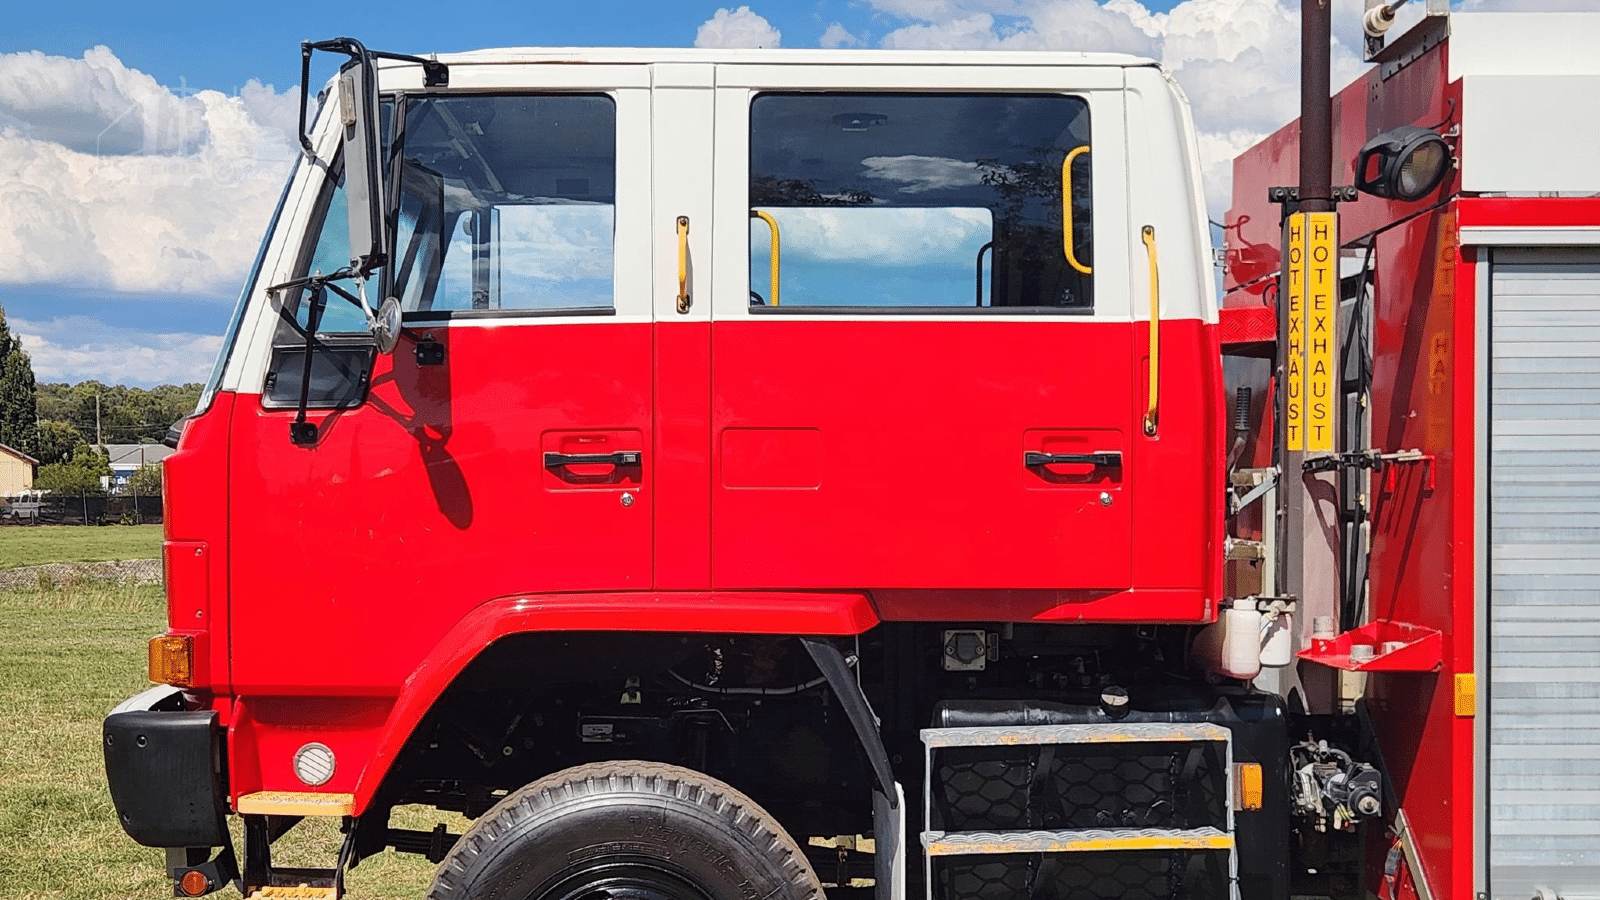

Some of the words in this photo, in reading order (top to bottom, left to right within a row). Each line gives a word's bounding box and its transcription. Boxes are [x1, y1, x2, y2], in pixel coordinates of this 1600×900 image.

[1290, 225, 1302, 286] HOT
[1313, 224, 1329, 285] HOT
[1288, 295, 1300, 442] EXHAUST
[1313, 294, 1327, 442] EXHAUST
